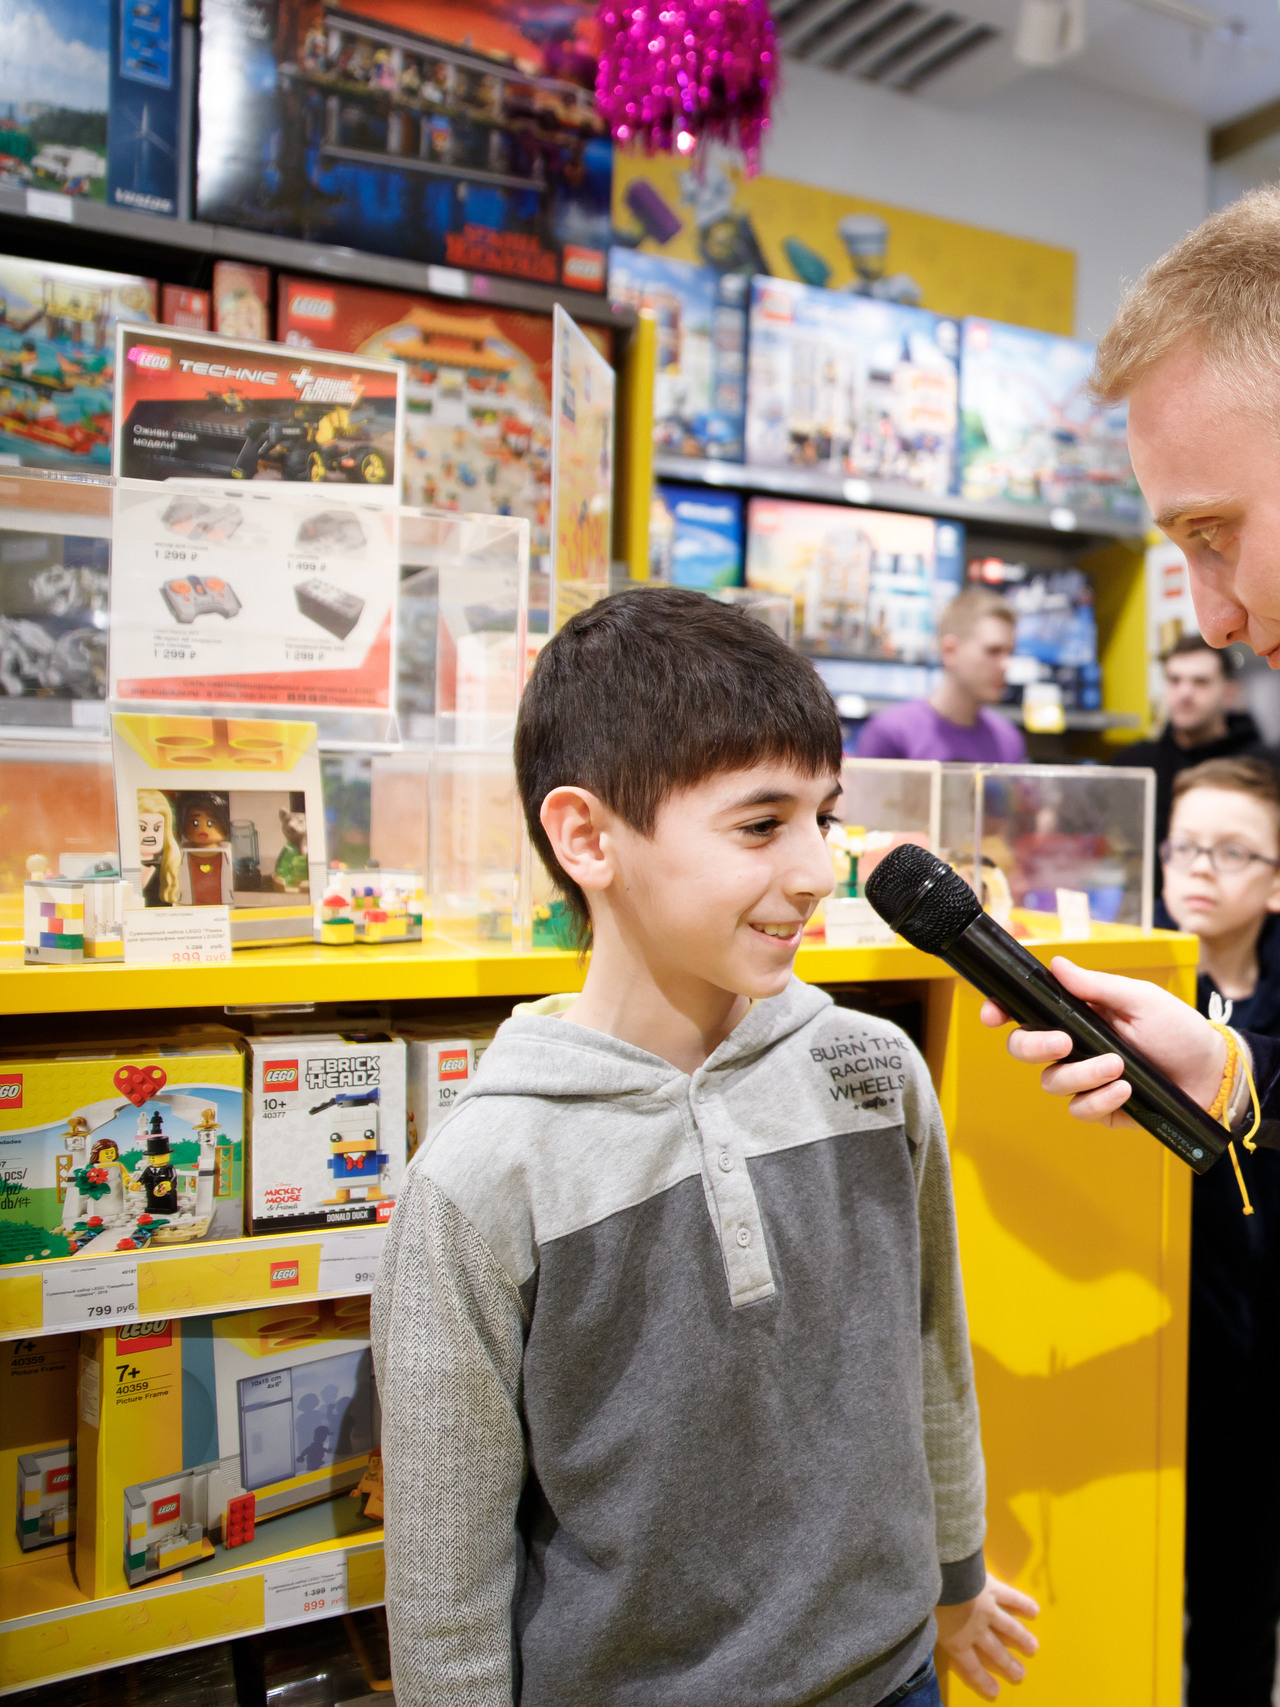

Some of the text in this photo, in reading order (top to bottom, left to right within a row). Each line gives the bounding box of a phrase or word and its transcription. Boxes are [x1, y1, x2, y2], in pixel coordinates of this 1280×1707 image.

[137, 353, 170, 370] LEGO
[179, 359, 279, 386] TECHNIC
[133, 424, 198, 441] Оживи свои
[172, 952, 200, 962] 899
[809, 1036, 909, 1062] BURN THE
[324, 1056, 380, 1073] BRICK
[440, 1058, 466, 1072] LEGO
[829, 1055, 903, 1082] RACING
[265, 1068, 297, 1083] LEGO
[438, 1088, 458, 1099] 10+
[829, 1074, 906, 1101] WHEELS
[263, 1098, 287, 1110] 10+
[262, 1111, 286, 1119] 40377
[4, 1168, 28, 1184] pcs/
[264, 1187, 302, 1197] MICKEY
[265, 1195, 302, 1204] MOUSE
[326, 1210, 368, 1223] DONALD DUCK
[272, 1267, 298, 1281] LEGO
[354, 1272, 376, 1282] 999
[87, 1302, 138, 1318] 799 руб.
[120, 1320, 168, 1339] LEGO
[10, 1356, 45, 1367] 40359
[11, 1368, 39, 1376] Picture
[116, 1364, 140, 1382] 7+
[116, 1382, 149, 1394] 40359
[251, 1378, 270, 1387] 10x15
[116, 1390, 169, 1405] Picture Frame
[157, 1502, 178, 1515] LEGO
[304, 1599, 326, 1612] 899
